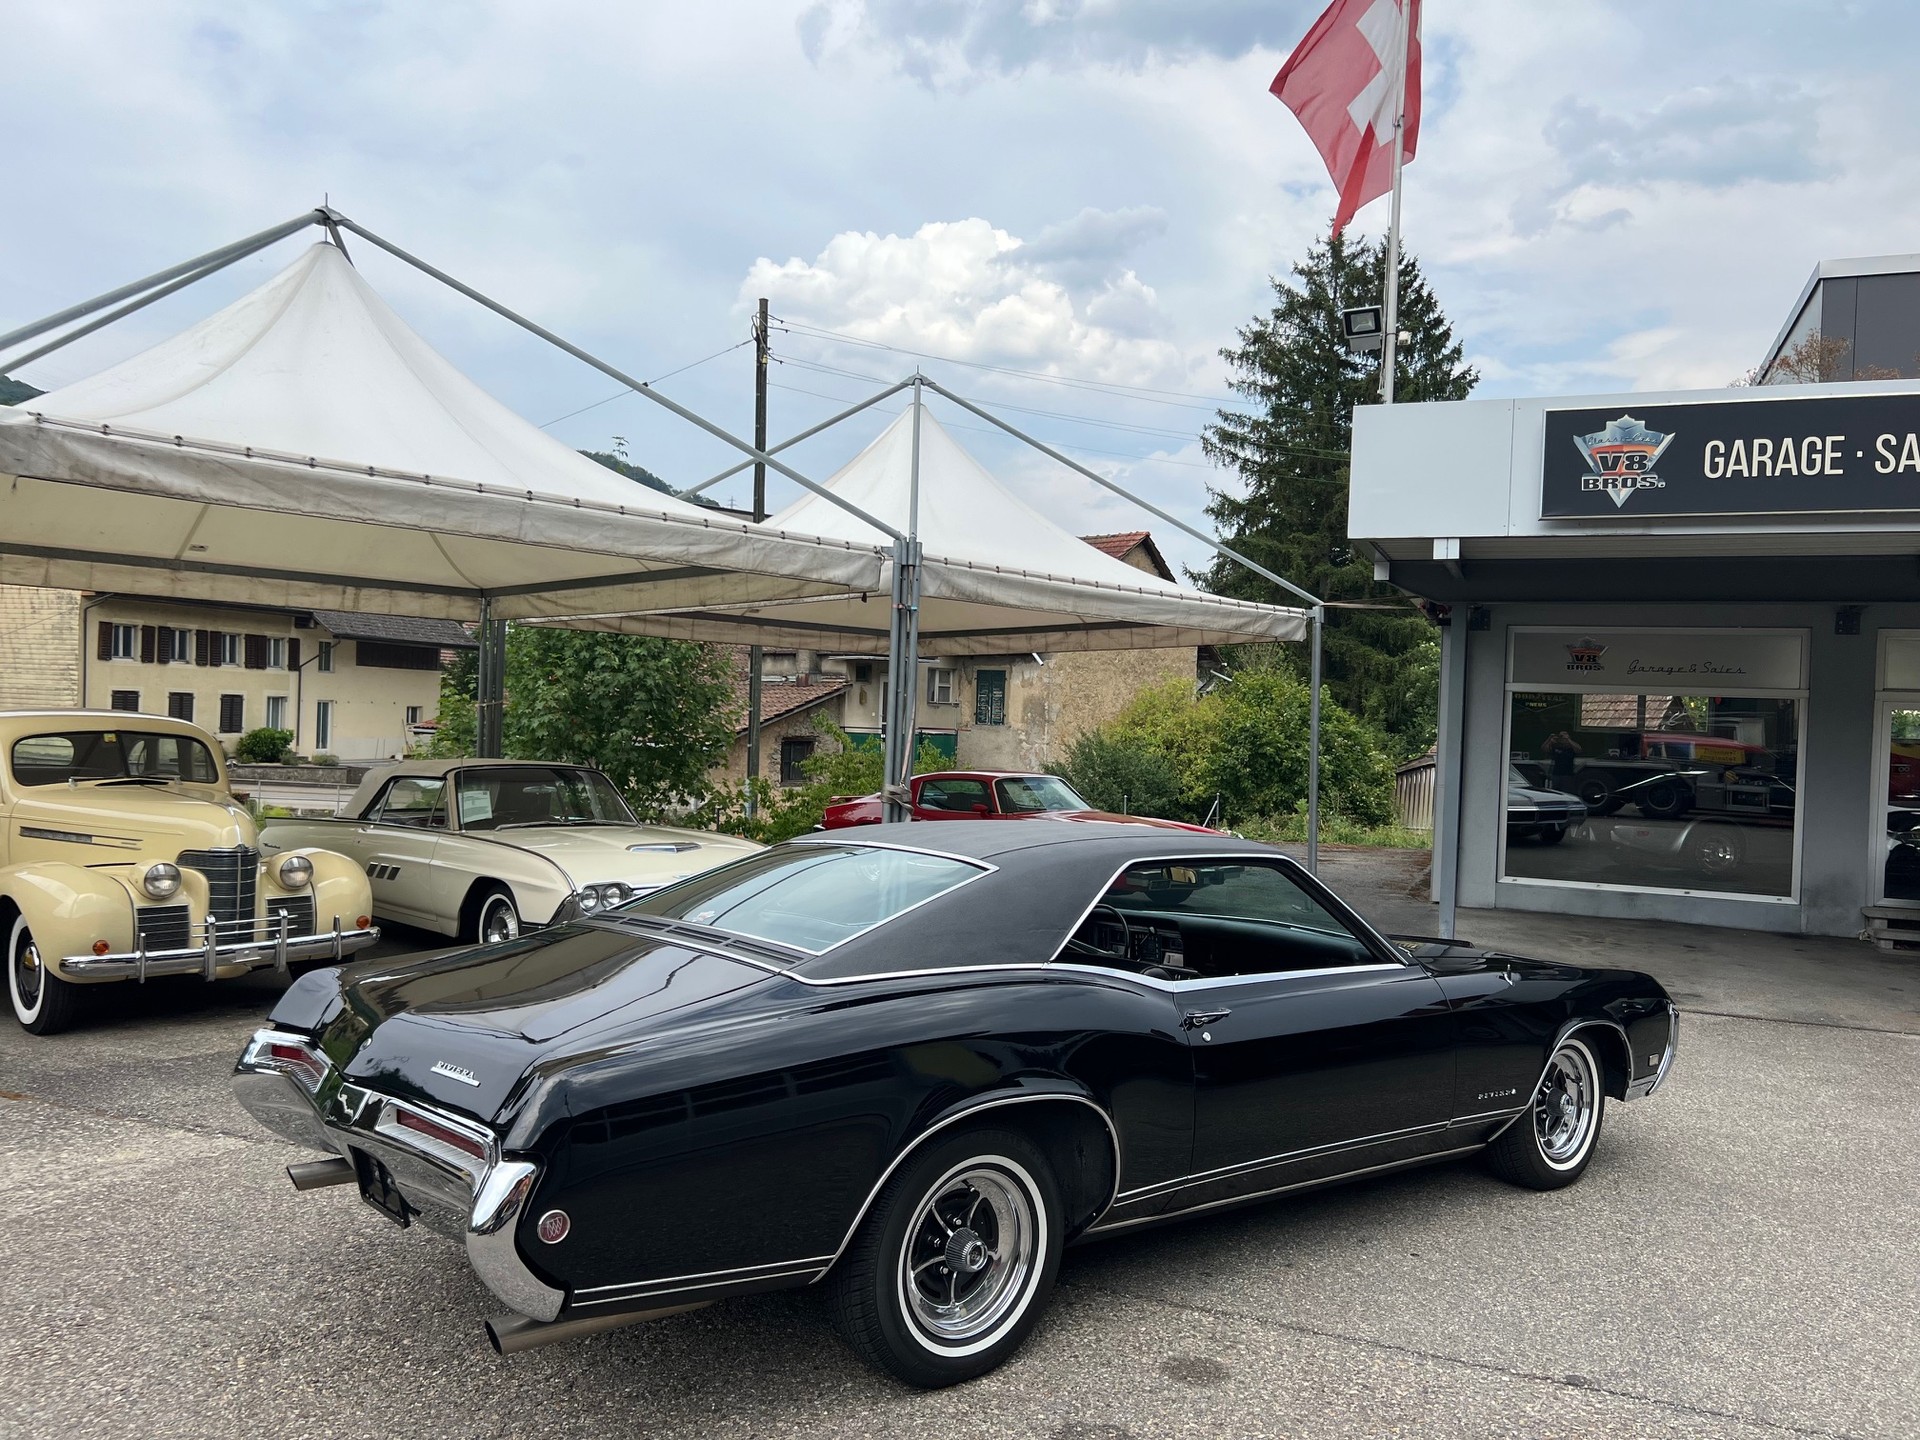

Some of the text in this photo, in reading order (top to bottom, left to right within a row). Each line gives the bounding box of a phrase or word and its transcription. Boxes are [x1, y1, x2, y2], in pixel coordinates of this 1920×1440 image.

[1597, 452, 1649, 473] V8
[1704, 435, 1846, 479] GARAGE
[1581, 474, 1666, 491] BROS.
[1574, 654, 1598, 662] V8
[1627, 659, 1747, 675] Garage & Sales
[436, 1060, 475, 1080] RIVIERA
